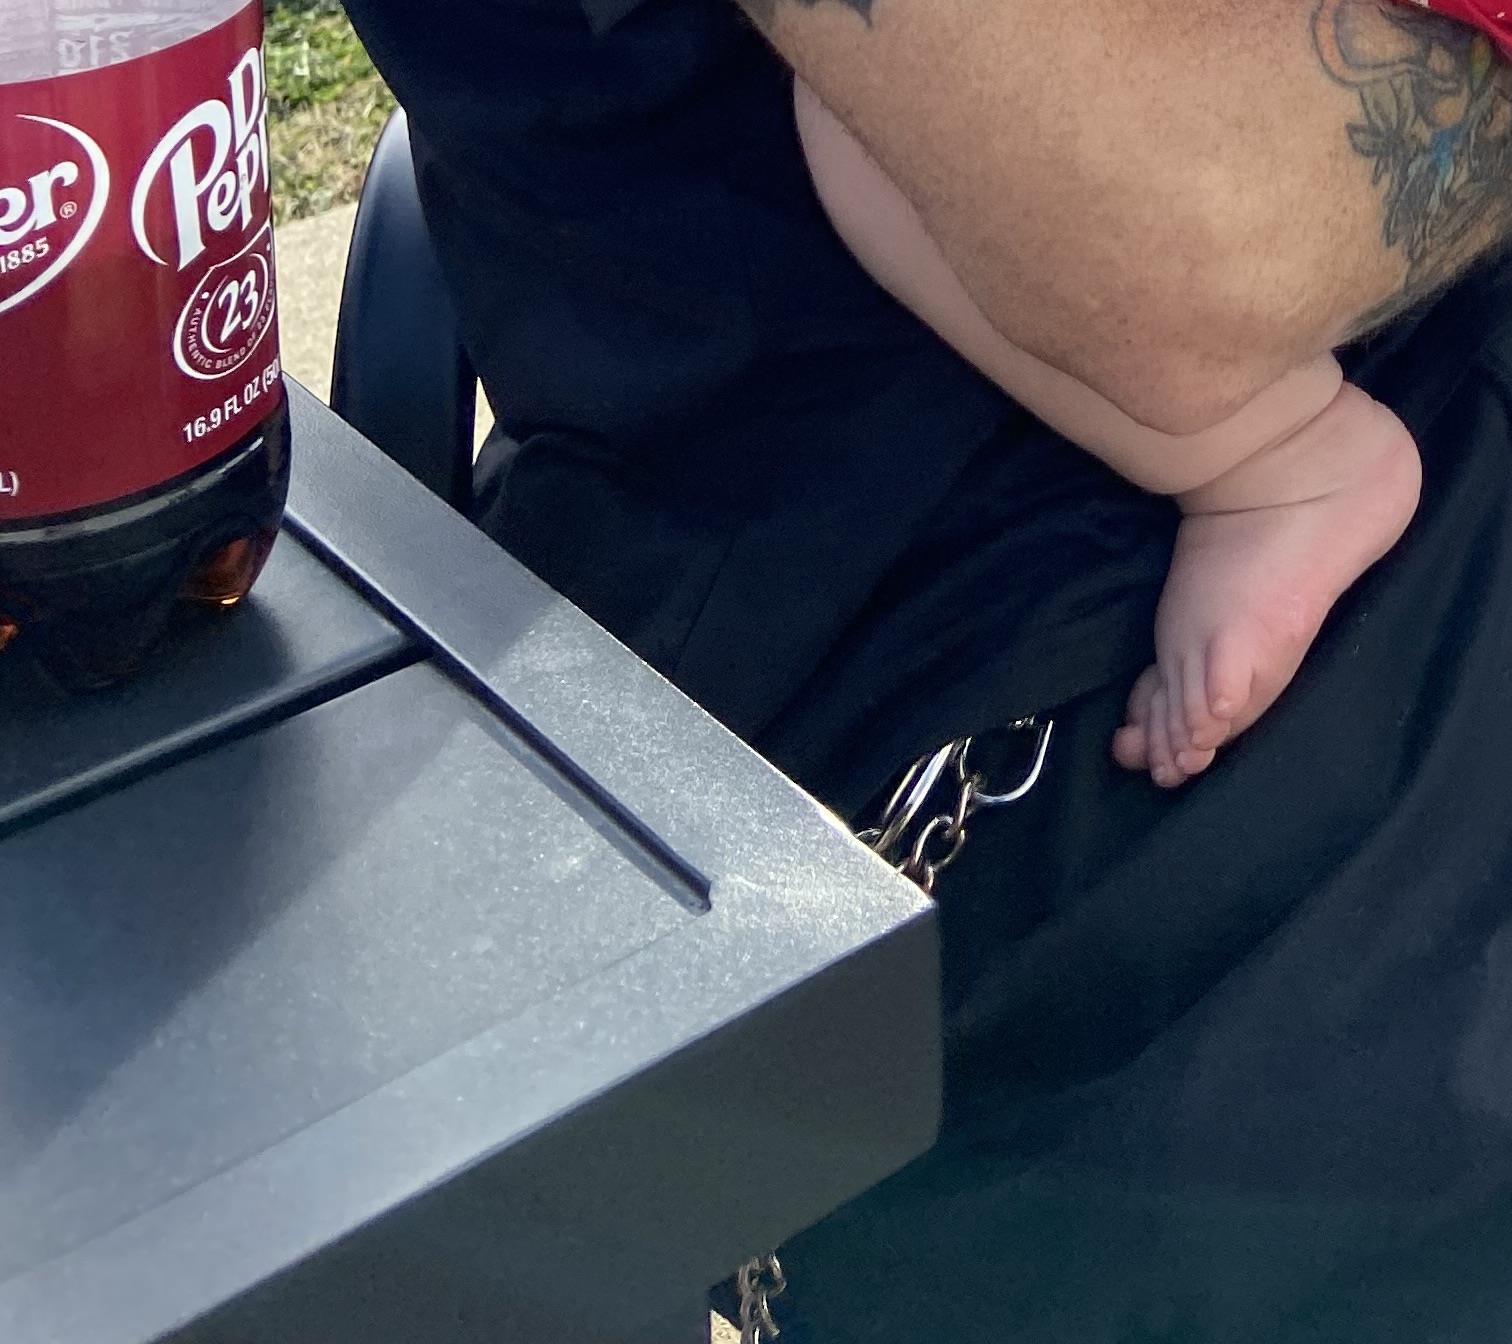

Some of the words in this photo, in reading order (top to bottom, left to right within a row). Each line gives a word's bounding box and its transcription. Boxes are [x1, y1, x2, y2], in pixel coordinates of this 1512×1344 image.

[187, 307, 213, 369] AUTHENTIC
[215, 346, 246, 370] BLEND
[218, 269, 259, 344] 23
[182, 407, 222, 443] 16.9
[223, 394, 243, 421] FL
[243, 375, 261, 405] OZ
